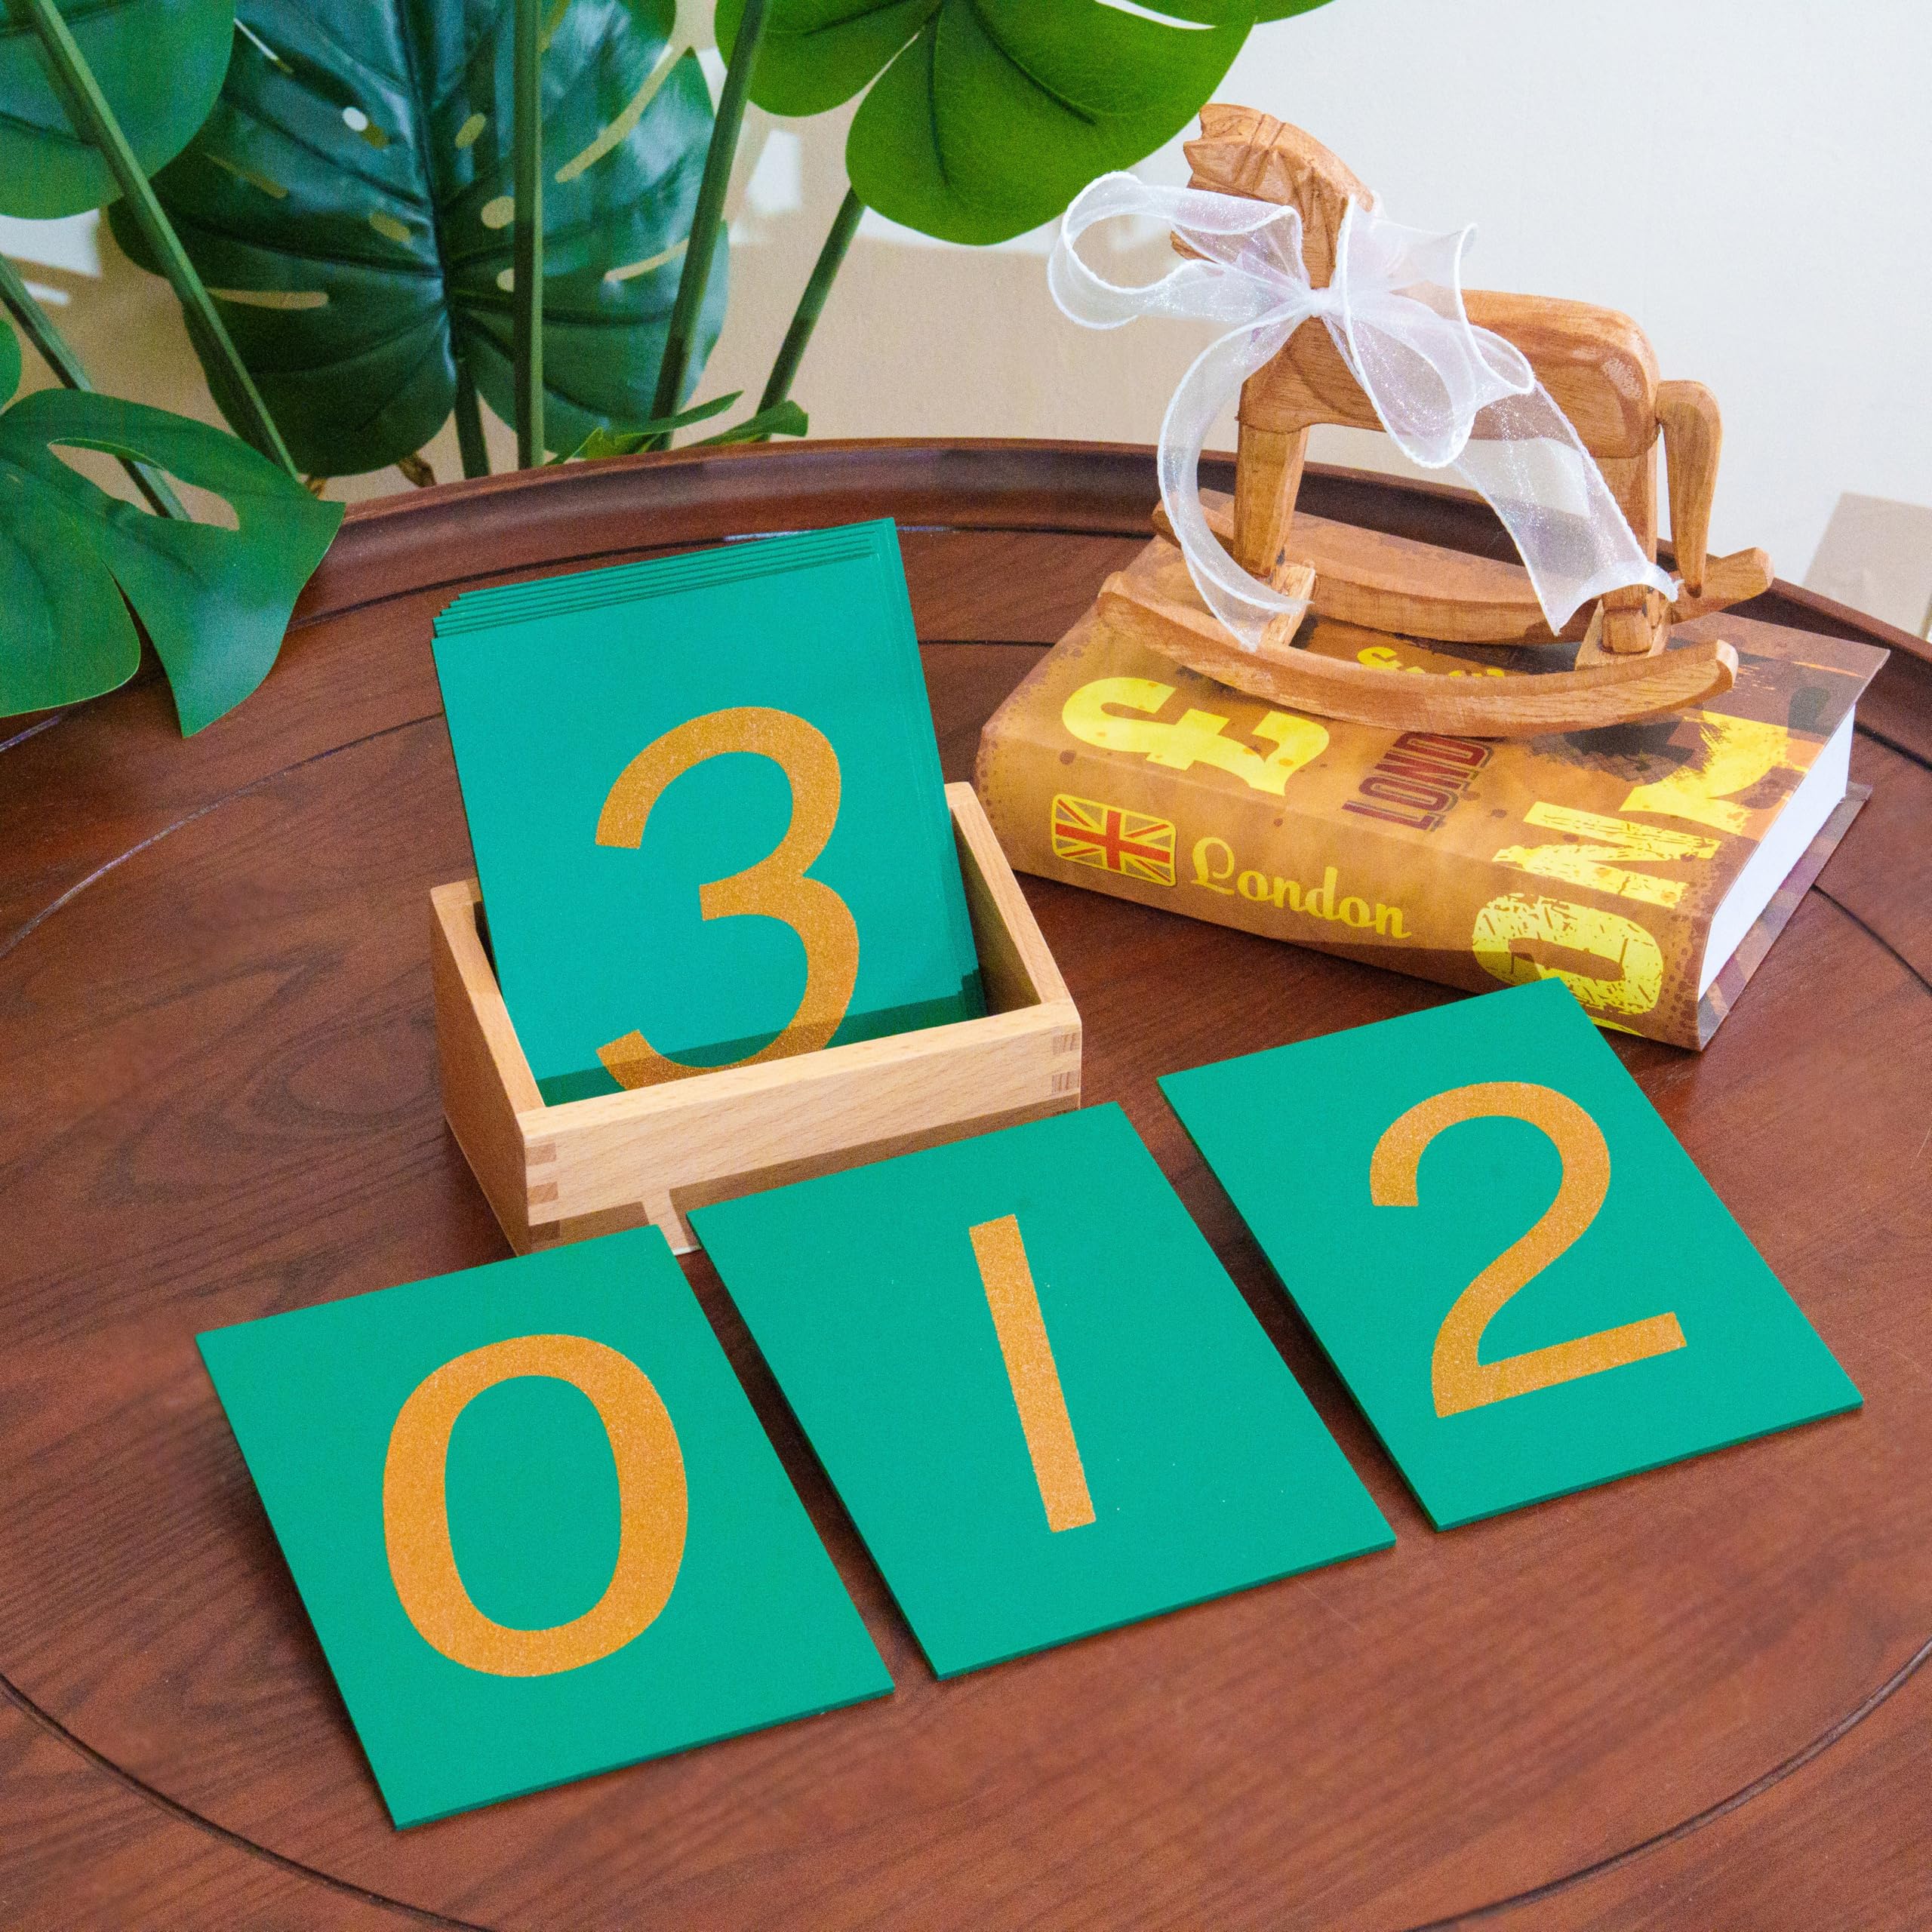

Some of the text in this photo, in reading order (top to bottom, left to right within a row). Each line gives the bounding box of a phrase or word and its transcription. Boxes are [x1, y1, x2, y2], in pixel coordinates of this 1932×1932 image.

[595, 706, 860, 1091] 3
[1191, 836, 1412, 939] London
[1341, 731, 1495, 832] LOND
[968, 1214, 1097, 1534] 1
[1369, 1081, 1687, 1419] 2
[382, 1334, 689, 1678] 0
